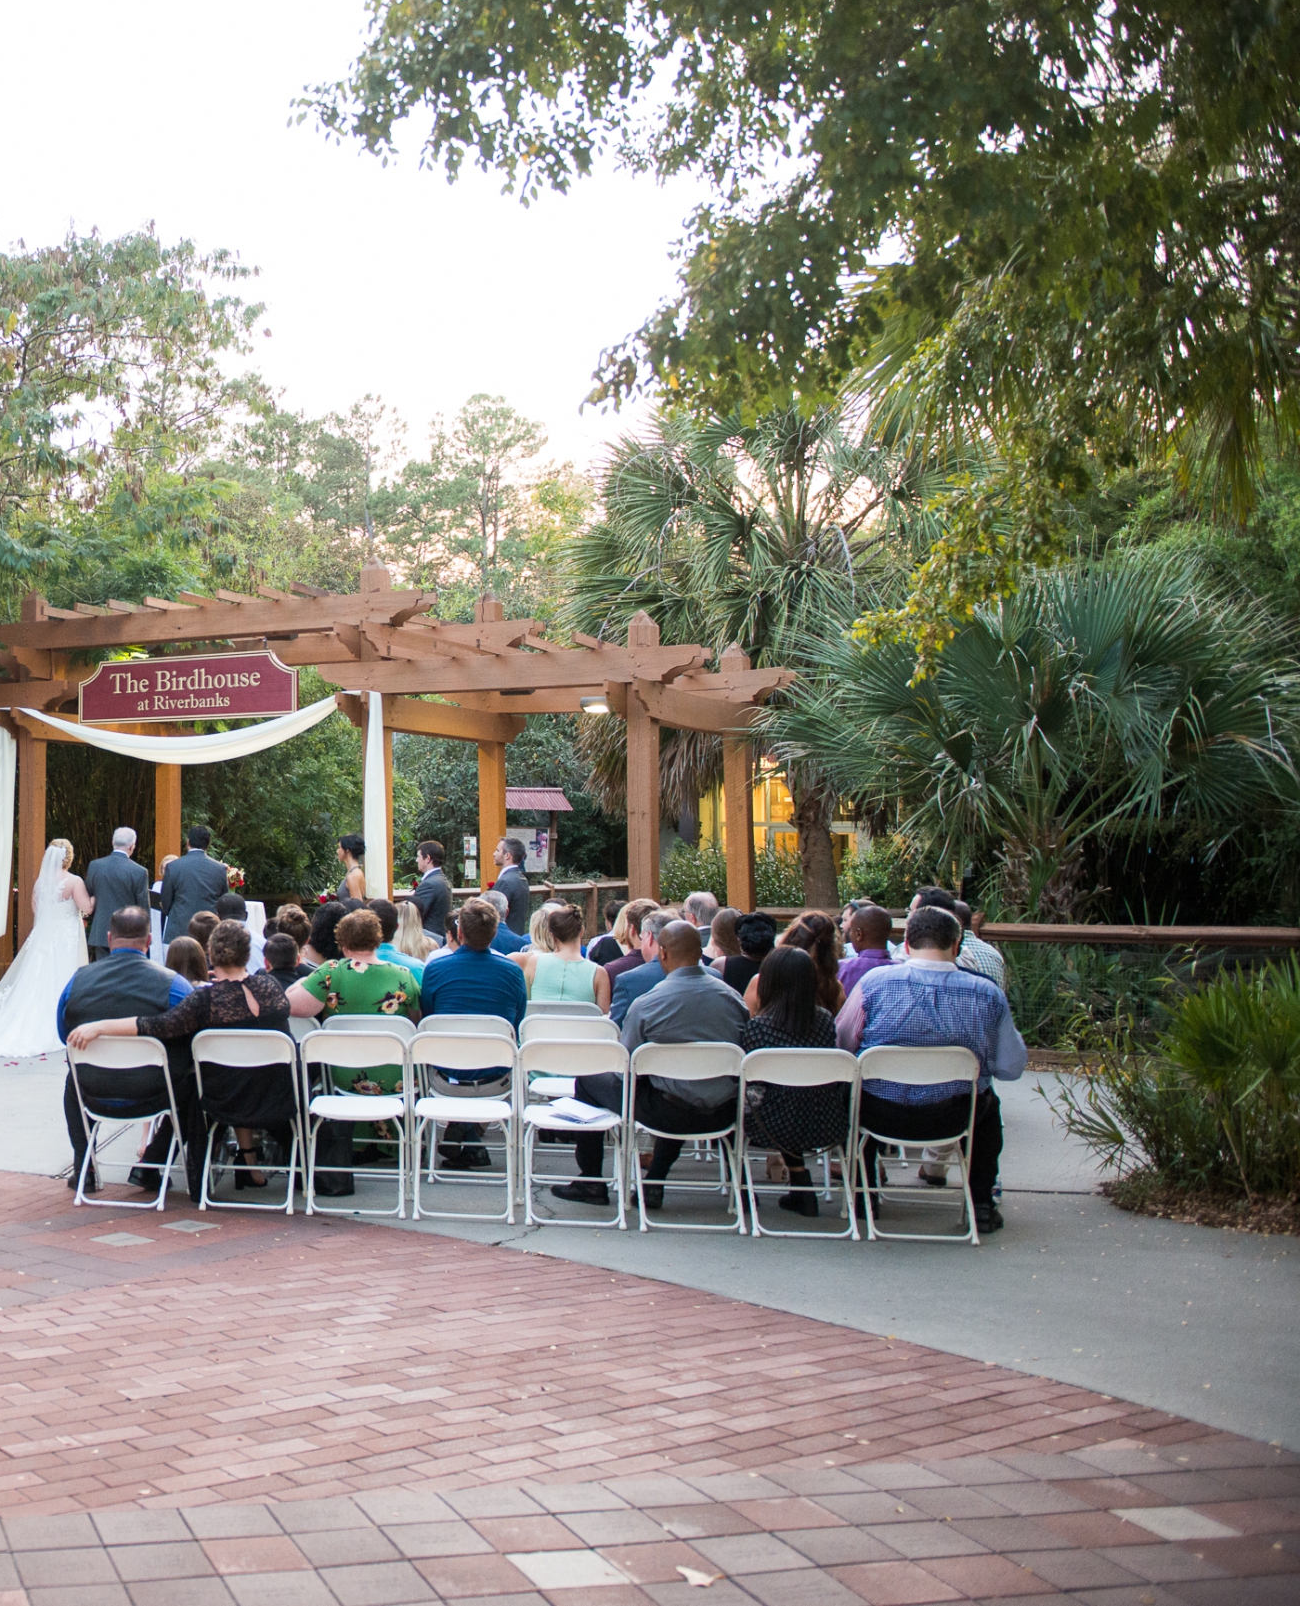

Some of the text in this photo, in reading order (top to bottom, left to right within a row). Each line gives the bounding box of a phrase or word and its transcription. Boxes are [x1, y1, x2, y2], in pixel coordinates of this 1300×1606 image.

[109, 667, 262, 694] The Birdhouse
[137, 692, 231, 712] at Riverbanks
